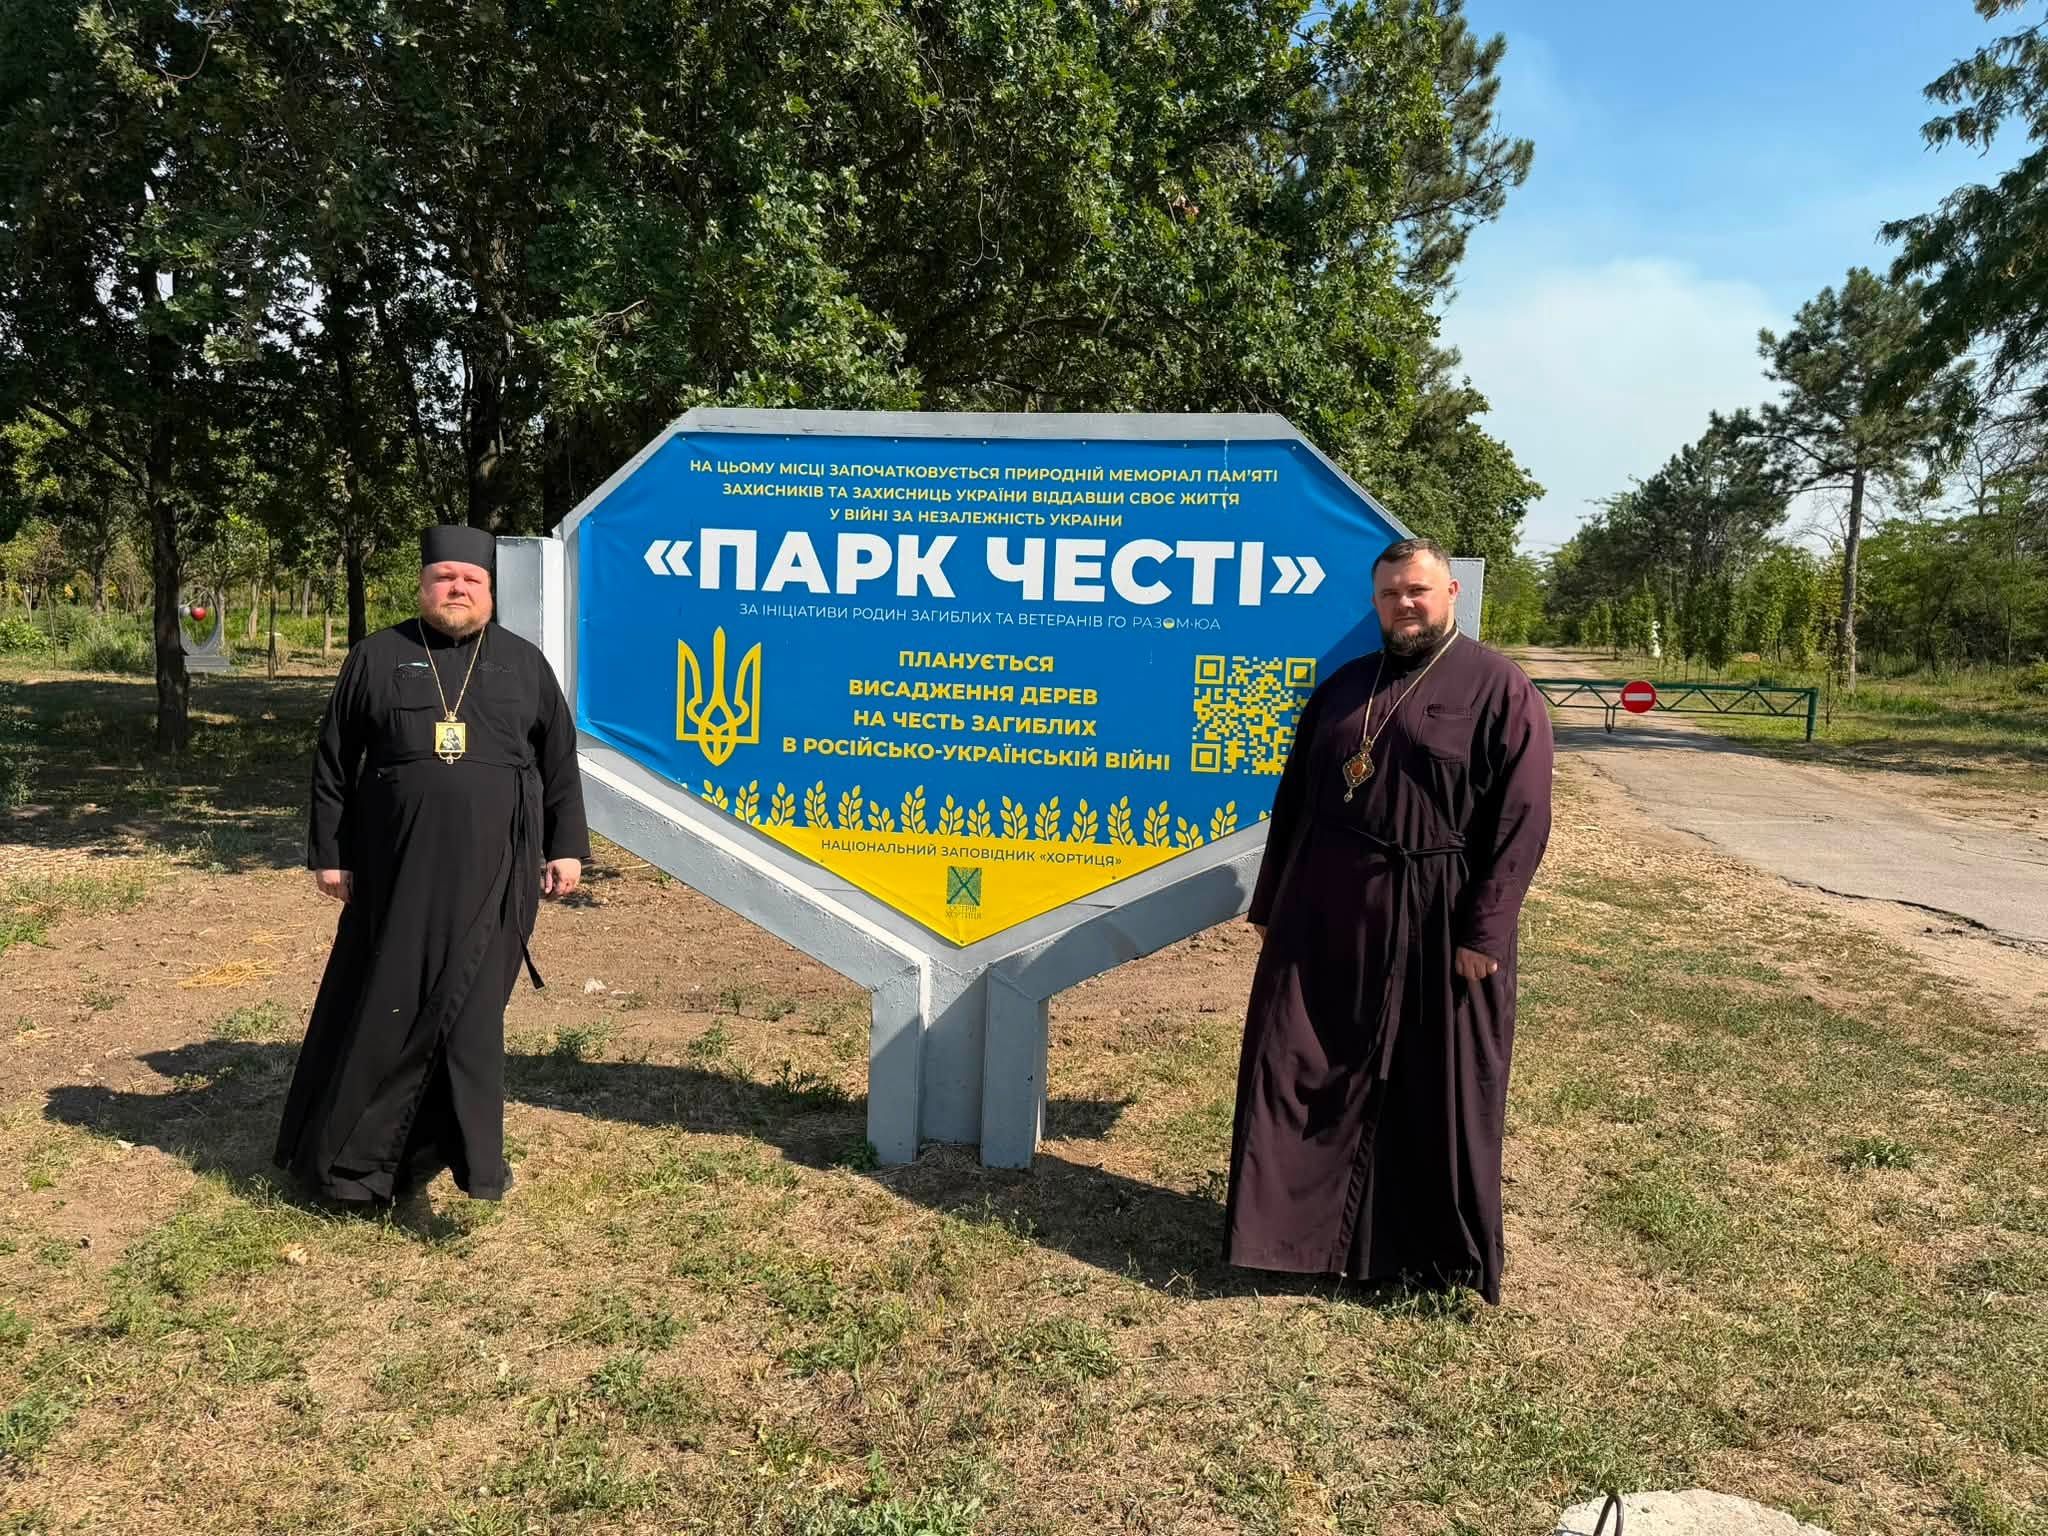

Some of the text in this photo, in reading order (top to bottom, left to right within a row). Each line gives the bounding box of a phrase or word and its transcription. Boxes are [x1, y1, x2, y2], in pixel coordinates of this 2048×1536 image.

[690, 459, 1278, 483] НА ЦЬОМУ МІСЦІ ЗАПОЧАТКОВУЄТЬСЯ ПРИРОДНІЙ МЕМОРІАЛ ПАМ’ЯТІ
[722, 483, 1240, 506] ЗАХИСНИКІВ ТА ЗАХИСНИЦЬ УКРАЇНИ ВІДДАВШИ СВОЄ ЖИТТЯ
[830, 508, 840, 521] У
[844, 506, 888, 522] ВІЙНІ
[893, 509, 913, 523] ЗА
[918, 511, 1045, 526] НЕЗАЛЕЖНІСТЬ
[643, 527, 1326, 606] «ПАРК ЧЕСТІ»
[739, 603, 758, 616] ЗА
[762, 604, 848, 619] ІНІЦІАТИВИ
[852, 607, 907, 622] РОДИН
[911, 609, 992, 625] ЗАГИБЛИХ
[995, 612, 1014, 626] ТА
[1018, 612, 1103, 628] ВЕТЕРАНІВ
[1108, 615, 1126, 629] ГО
[898, 650, 1055, 674] ПЛАНУЄТЬСЯ
[848, 678, 1099, 706] ВИСАДЖЕННЯ ДЕРЕВ
[852, 708, 1098, 737] НА ЧЕСТЬ ЗАГИБЛИХ
[782, 736, 1171, 771] В РОСІЙСЬКО-УКРАЇНСЬКІЙ ВІЙНІ
[821, 839, 1122, 867] НАЦІОНАЛЬНИЙ ЗАПОВІДНИК «ХОРТИЦЯ»
